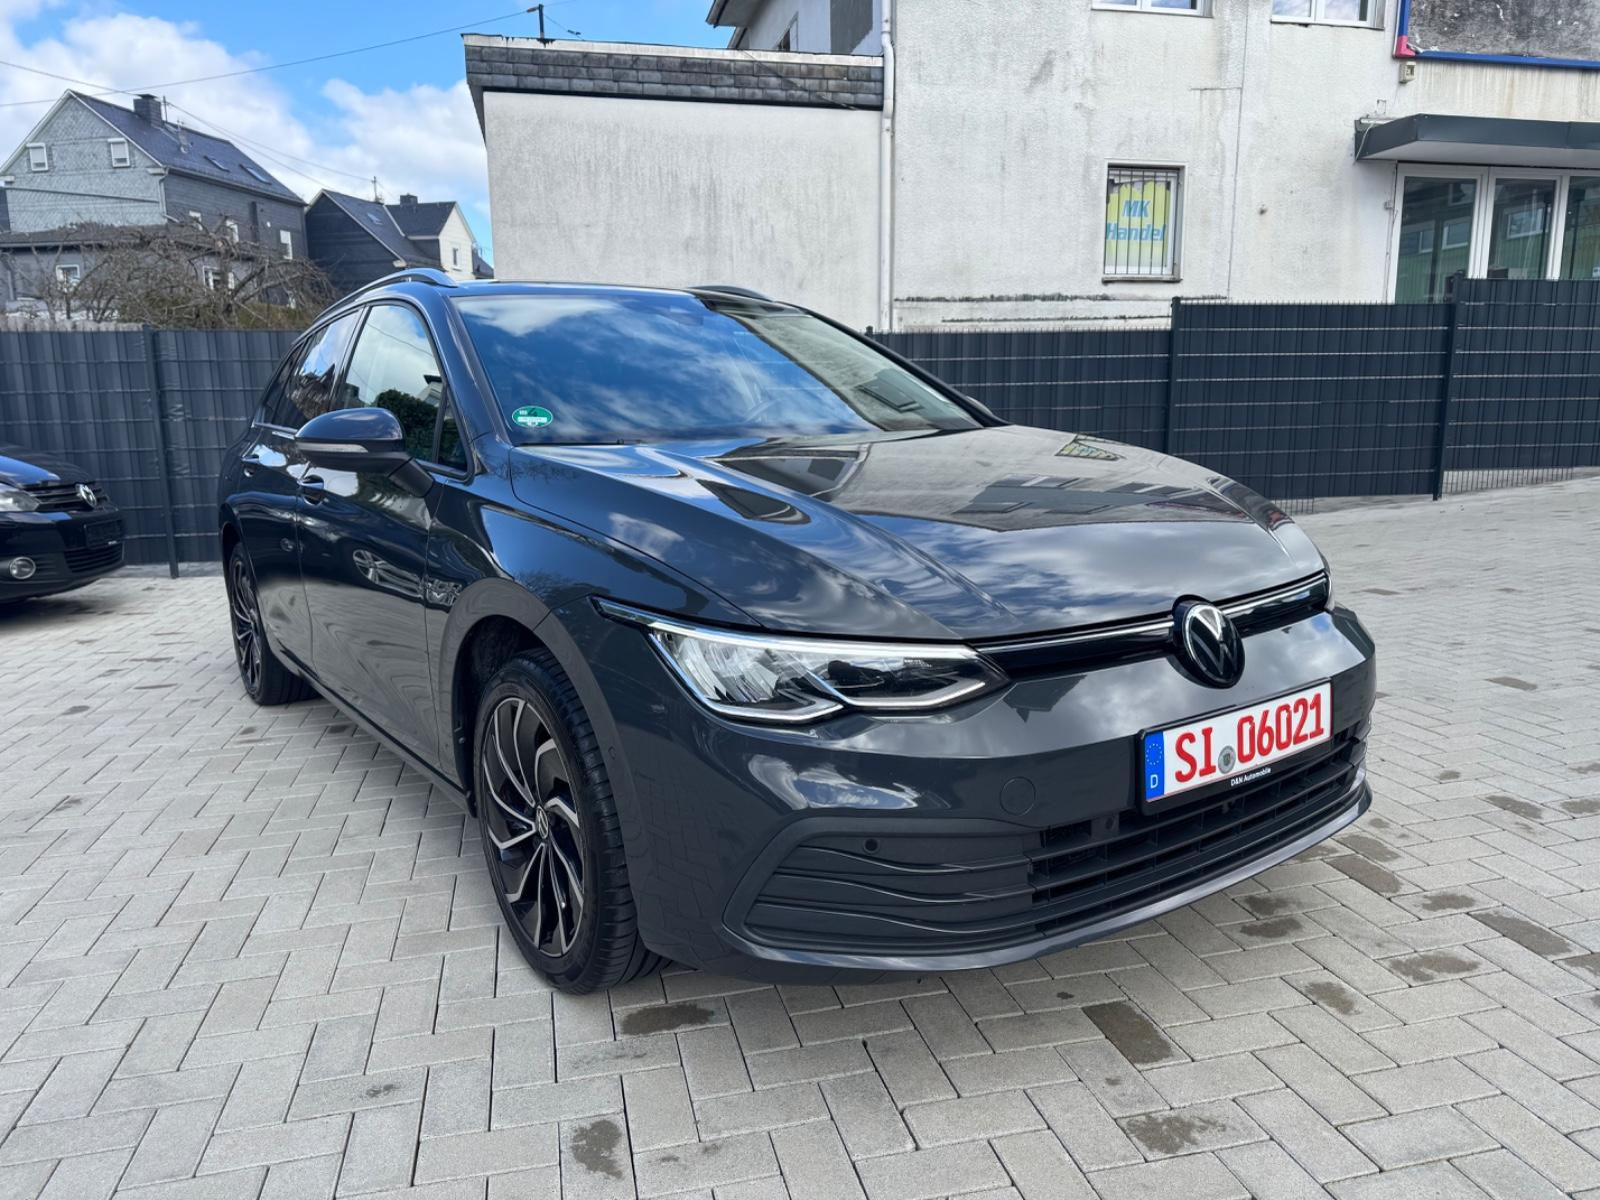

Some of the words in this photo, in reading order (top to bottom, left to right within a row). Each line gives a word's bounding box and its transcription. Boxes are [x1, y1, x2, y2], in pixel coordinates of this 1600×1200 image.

[1122, 200, 1151, 217] MK
[1106, 223, 1167, 241] Handel
[1174, 726, 1217, 783] SI
[1236, 692, 1324, 764] 06021
[1149, 774, 1159, 789] D
[1243, 766, 1272, 783] Automobile
